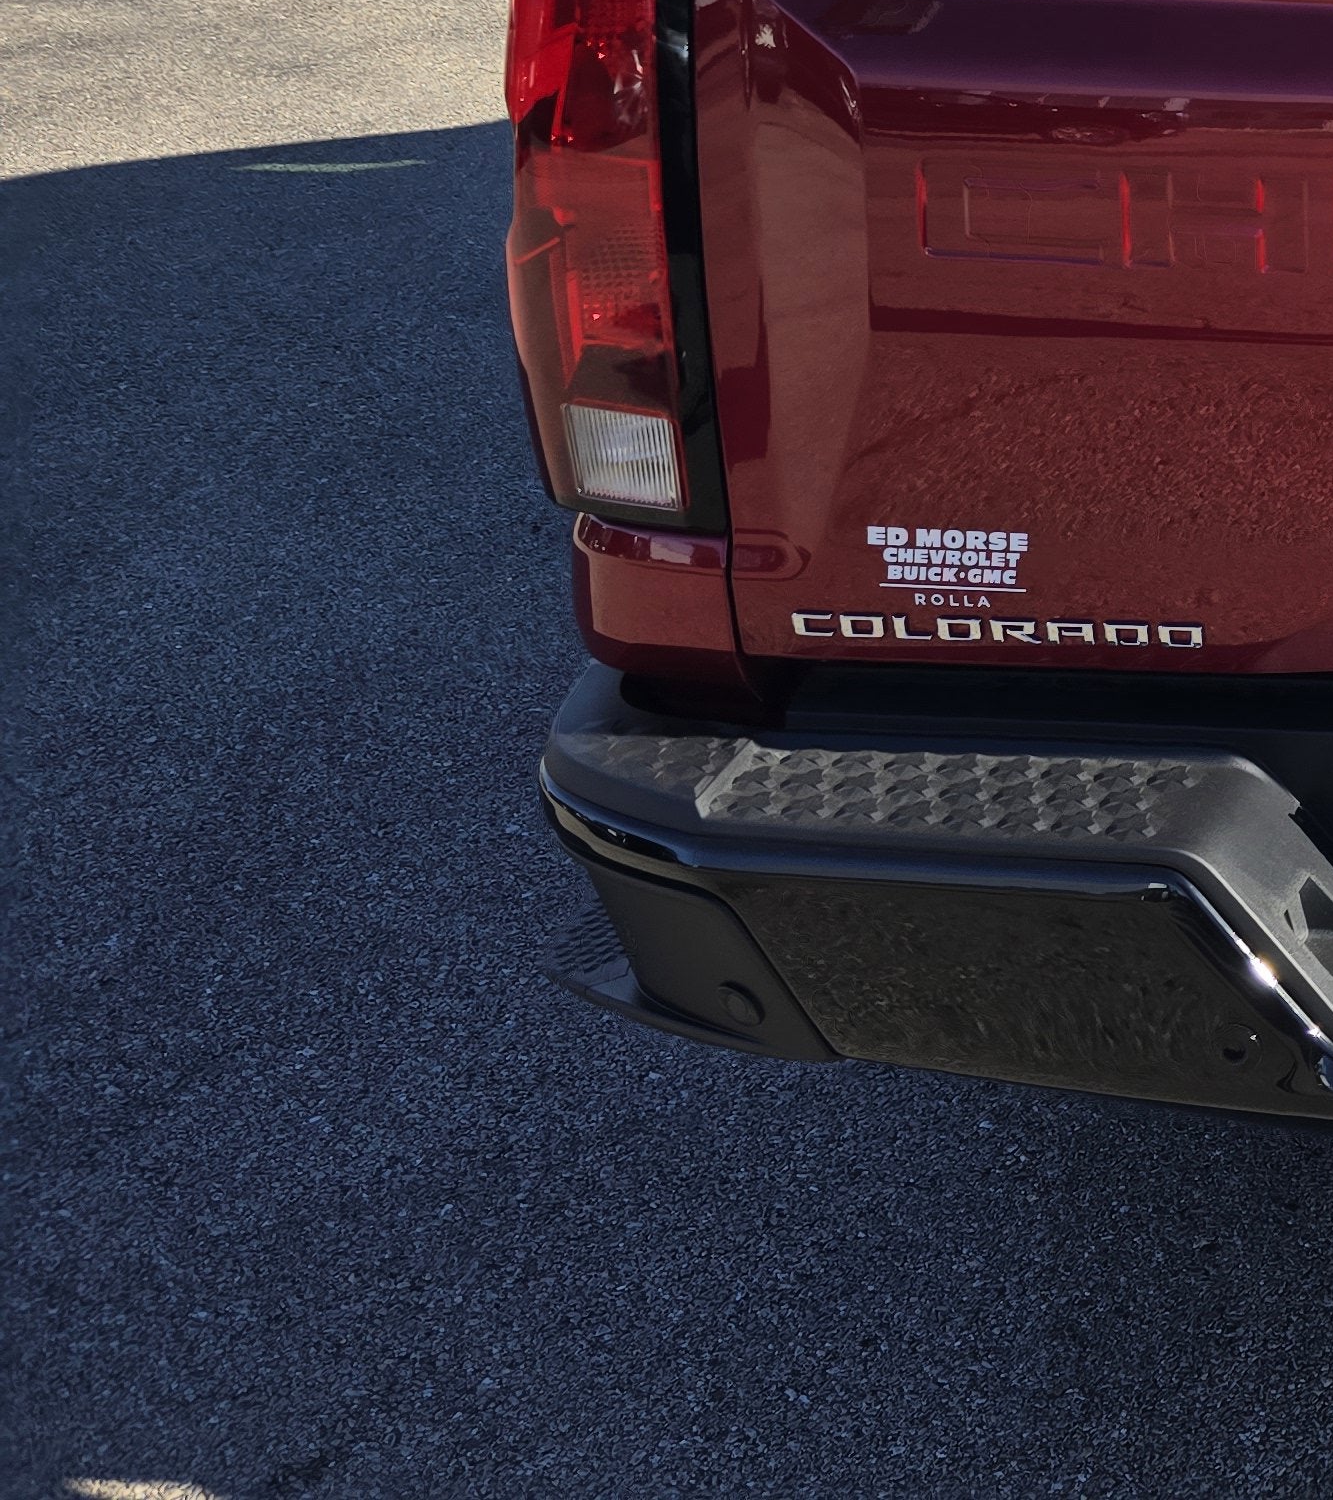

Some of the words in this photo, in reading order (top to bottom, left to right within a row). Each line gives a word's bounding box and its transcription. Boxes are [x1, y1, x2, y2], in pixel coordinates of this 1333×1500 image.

[867, 526, 909, 547] ED
[915, 528, 1029, 552] MORSE
[882, 547, 1020, 568] CHEVROLET
[914, 593, 991, 608] ROLLA
[791, 612, 1203, 648] COLORADO
